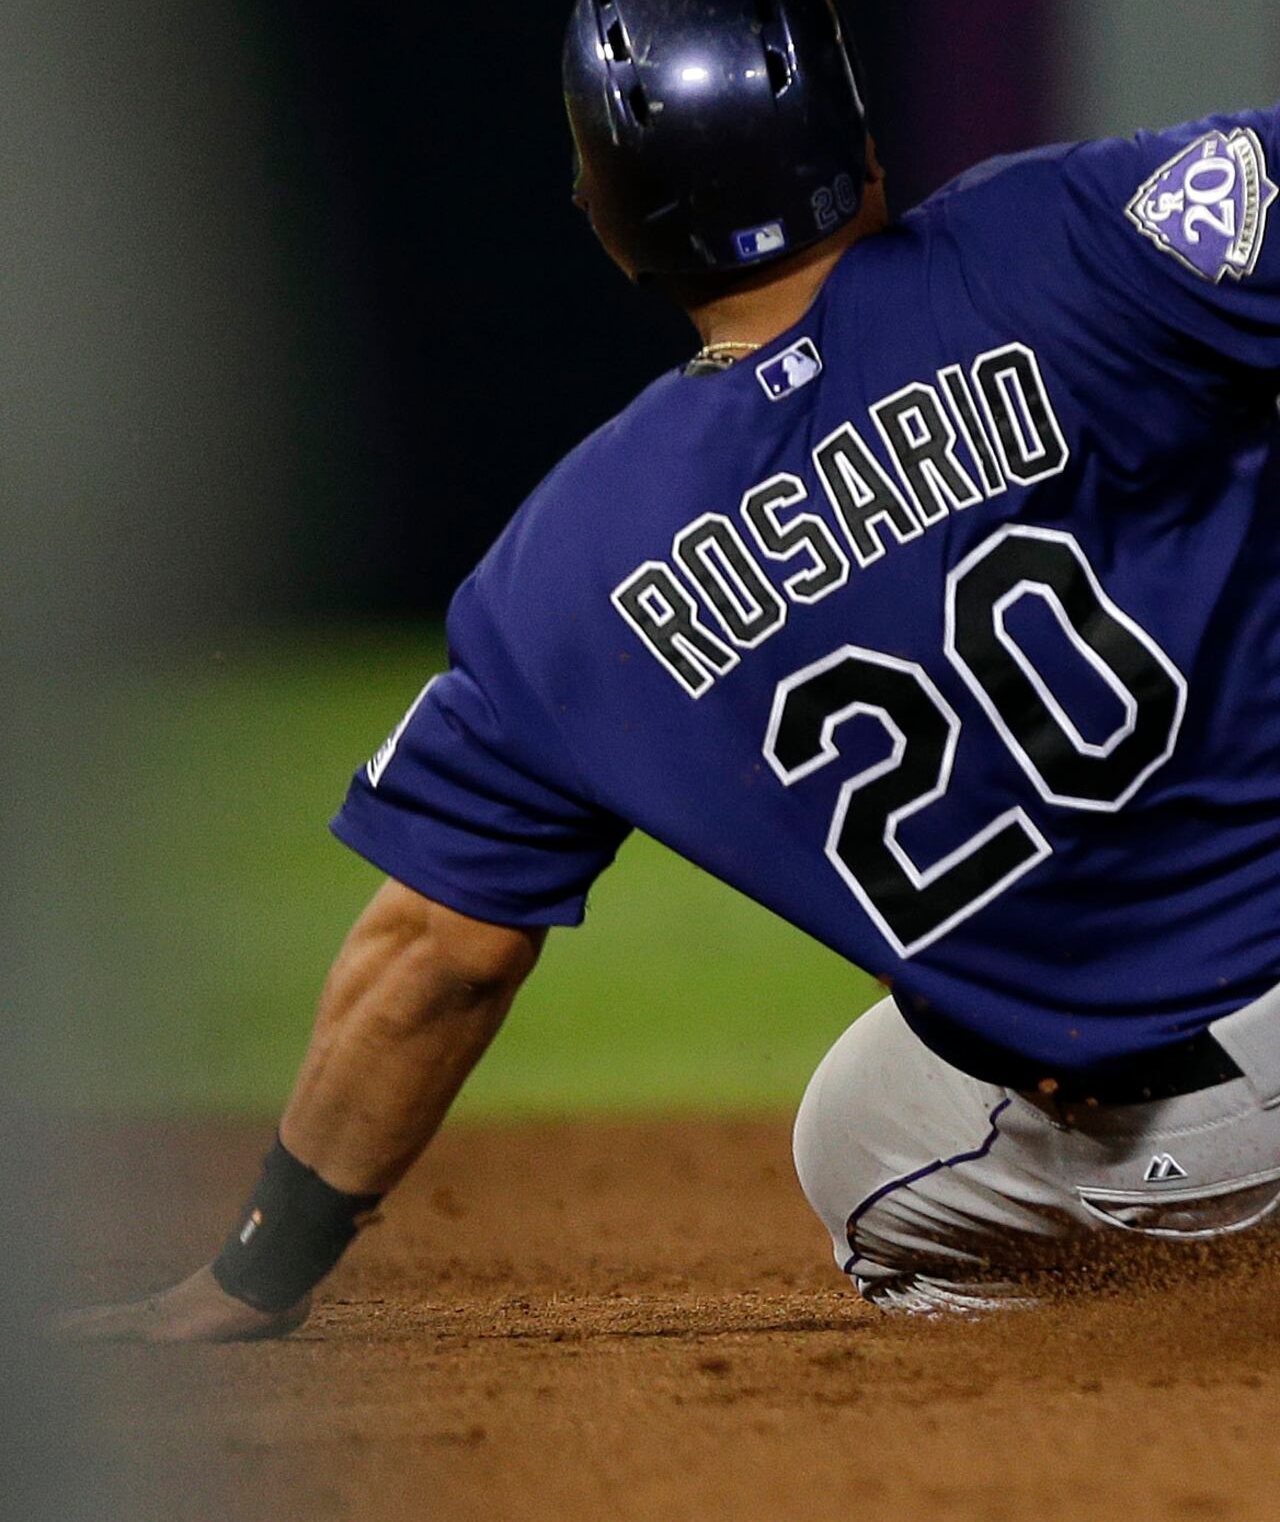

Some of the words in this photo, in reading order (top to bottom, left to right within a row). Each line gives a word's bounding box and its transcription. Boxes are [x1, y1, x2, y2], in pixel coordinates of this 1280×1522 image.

[811, 173, 857, 230] 20
[610, 341, 1070, 700] ROSARIO
[761, 522, 1188, 959] 20
